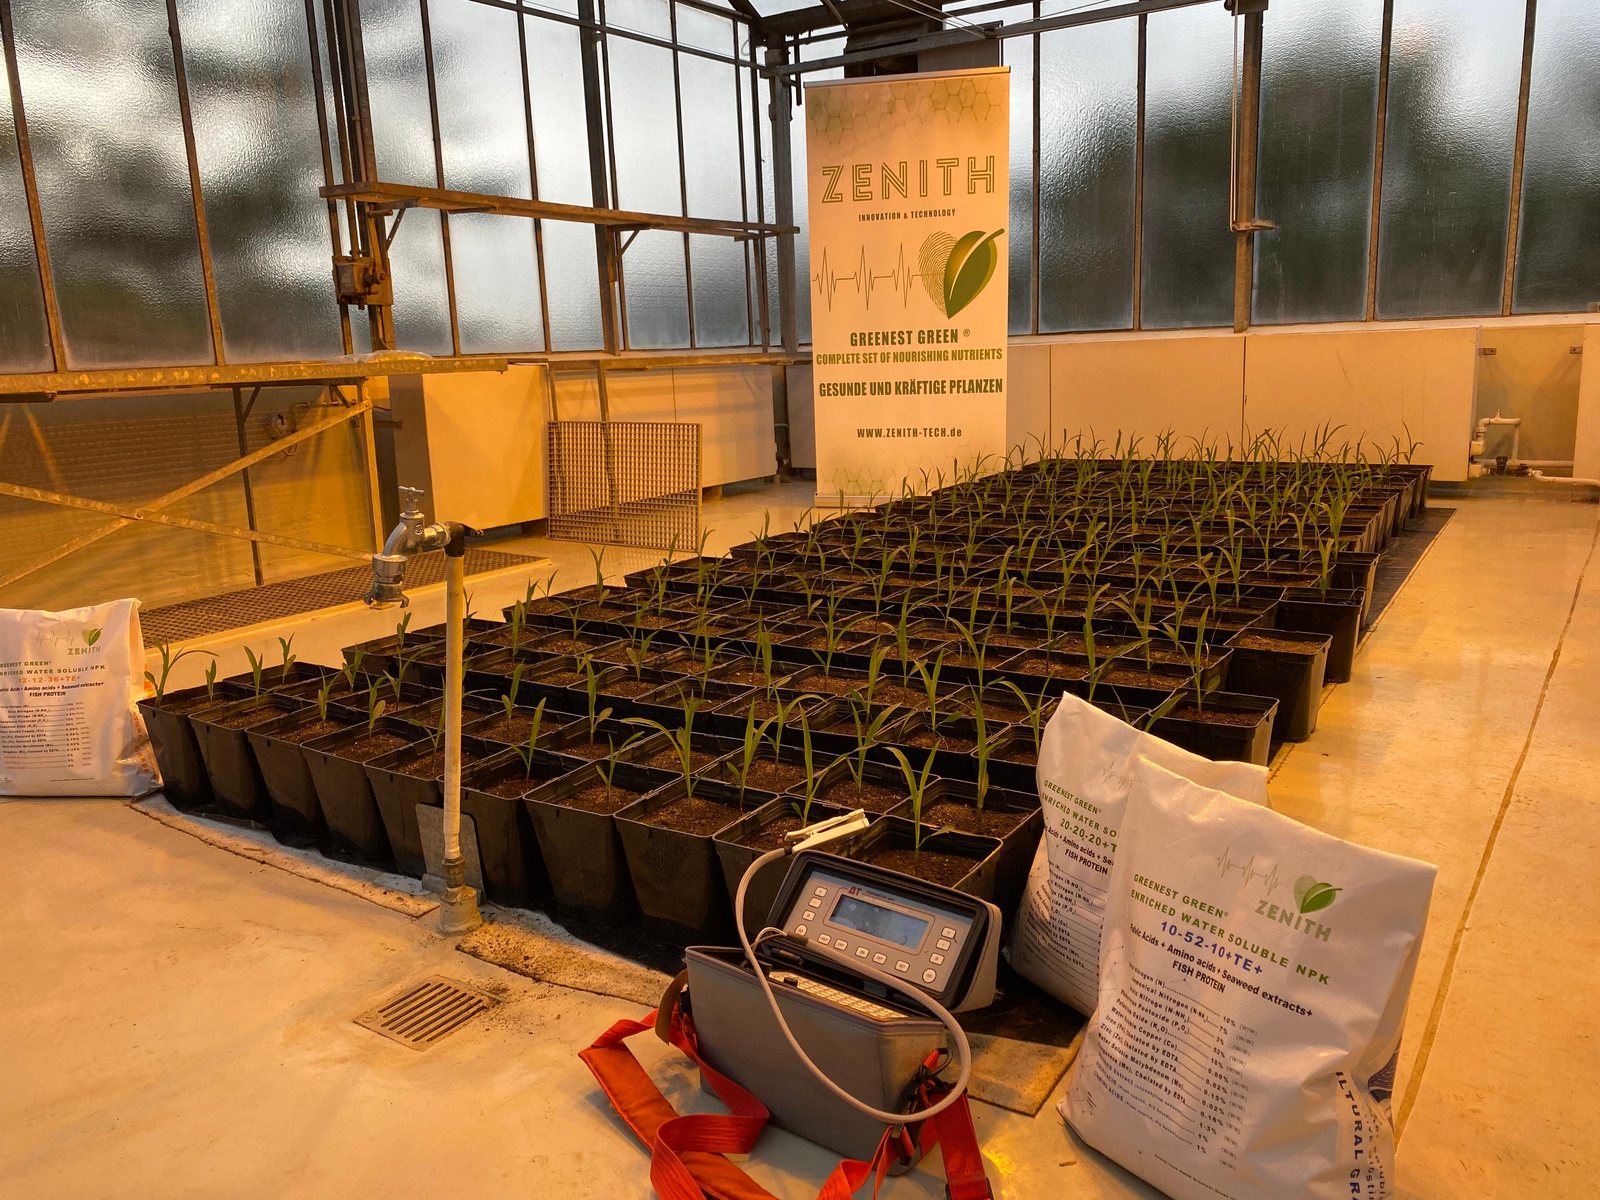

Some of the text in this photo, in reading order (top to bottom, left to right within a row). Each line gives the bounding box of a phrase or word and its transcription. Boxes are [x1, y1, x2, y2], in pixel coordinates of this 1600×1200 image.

[821, 155, 995, 204] ZENITH
[858, 212, 901, 221] INNOVATION
[911, 208, 956, 219] TECHNOLOGY
[850, 330, 913, 347] GREENEST
[918, 329, 958, 344] GREEN
[816, 348, 1002, 365] COMPLETE SET OF NOURISHING NUTRIENTS
[819, 379, 1003, 397] GESUNDE UND KRÄFTIGE PFLANZEN
[857, 427, 962, 438] WWW.ZENITH-TECH.de
[68, 646, 100, 655] ZENITH
[1044, 780, 1074, 801] GREENEST
[1041, 792, 1070, 814] ENRICHED
[1073, 810, 1100, 830] WATER
[1063, 836, 1079, 849] Amino
[1080, 846, 1095, 858] acids
[1065, 848, 1078, 861] FISH
[1079, 856, 1108, 875] PROTEIN
[1134, 874, 1179, 899] GREENEST
[1255, 899, 1331, 942] ZENITH
[1131, 889, 1330, 985] ENRICHED WATER SOLUBLE NPK
[1161, 921, 1262, 974] 10-52-10+TE+
[1142, 932, 1159, 946] Acids
[1167, 944, 1195, 963] Amino
[1197, 958, 1216, 973] acids
[1221, 969, 1260, 995] Seaweed
[1262, 990, 1313, 1017] extracts+
[1172, 960, 1226, 994] FISH PROTEIN
[1158, 991, 1189, 1010] Nitrogen
[1138, 1003, 1169, 1023] Pentoxide
[1100, 1023, 1112, 1035] Zinc
[1150, 1056, 1158, 1064] by
[1160, 1060, 1177, 1073] EDTA
[1106, 1015, 1117, 1025] Iron
[1152, 1044, 1160, 1053] by
[1161, 1050, 1179, 1061] EDTA
[1138, 1026, 1162, 1041] Copper
[1163, 1039, 1178, 1051] (Cu)
[1130, 1056, 1170, 1080] Molybdenum
[1135, 1070, 1163, 1090] Chelated
[1164, 1087, 1171, 1095] by
[1197, 1144, 1206, 1154] 1%
[1198, 1134, 1208, 1143] 1%
